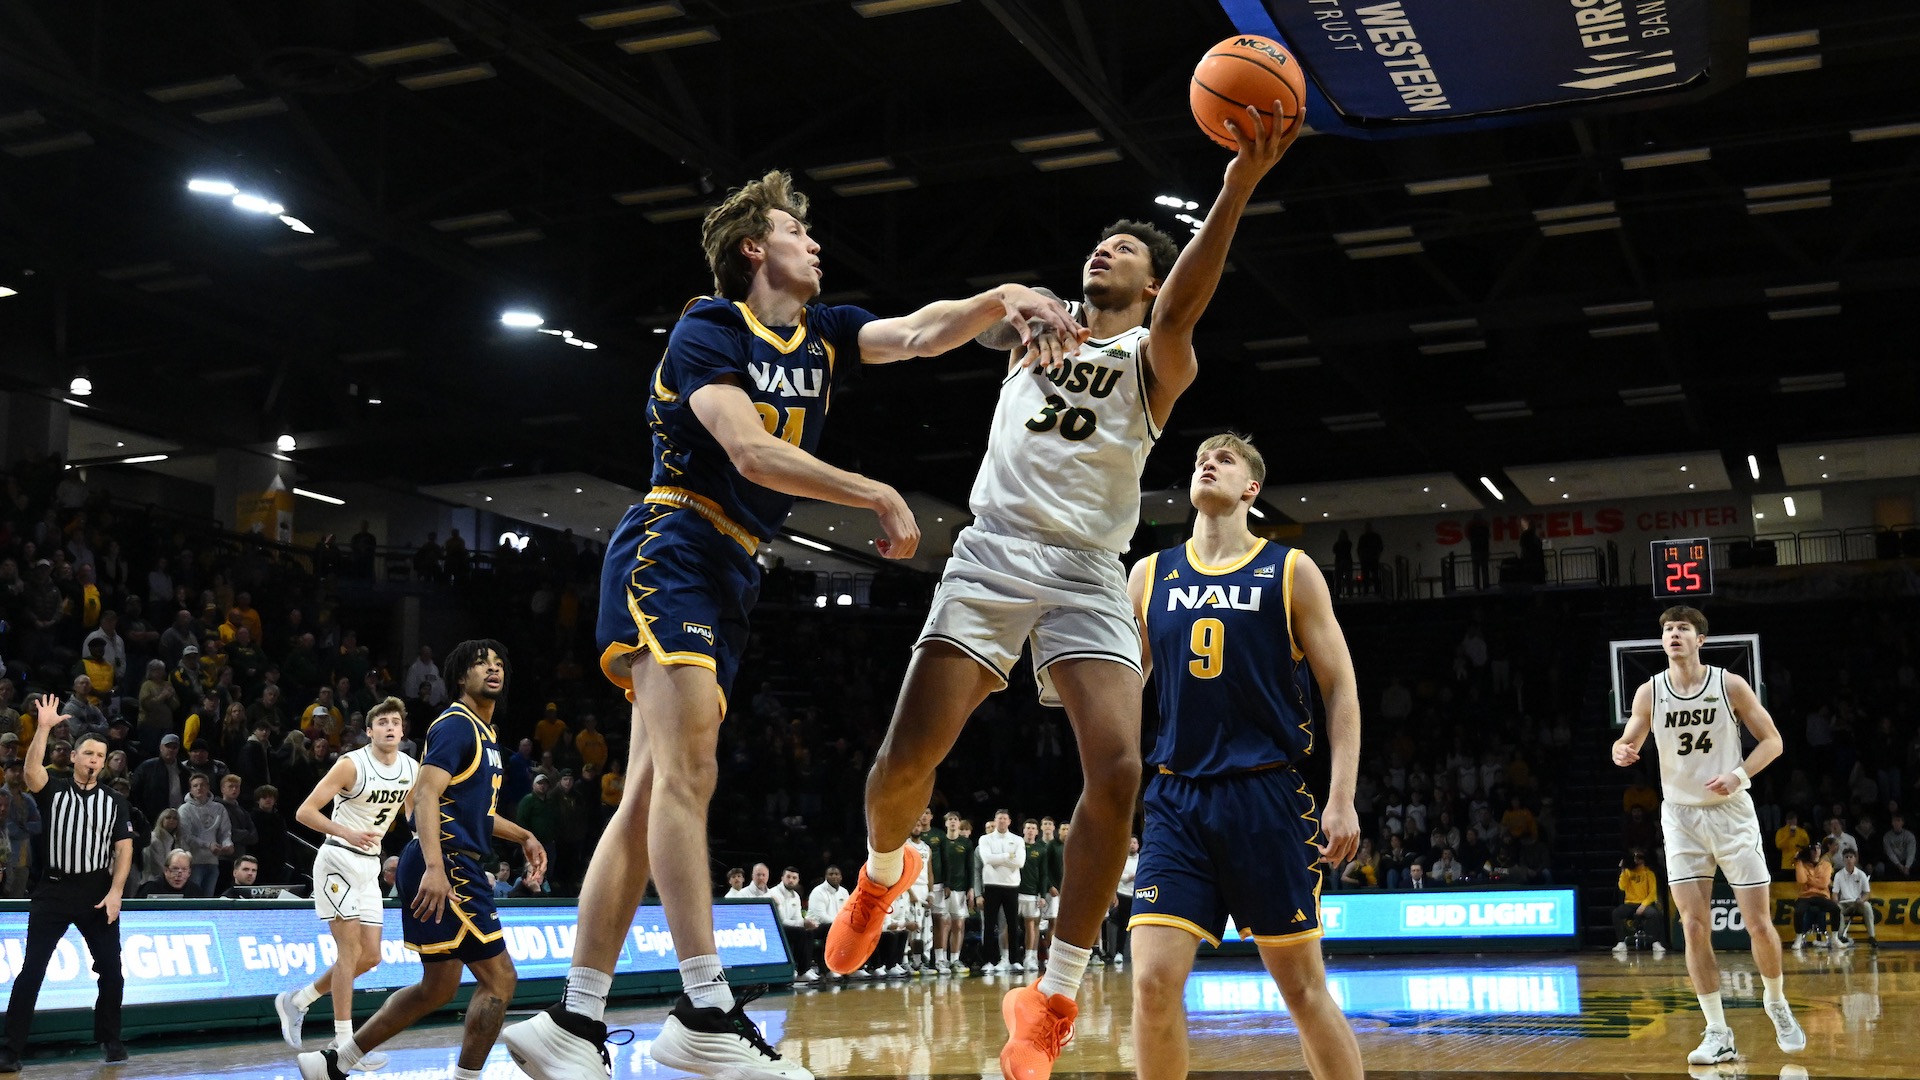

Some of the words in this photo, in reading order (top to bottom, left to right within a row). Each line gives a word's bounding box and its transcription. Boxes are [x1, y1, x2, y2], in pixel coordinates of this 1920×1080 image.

[1233, 38, 1287, 65] NCAA
[1355, 1, 1451, 112] WESTERN
[747, 361, 823, 397] NAU
[1033, 358, 1124, 398] DSU
[1025, 394, 1097, 441] 30
[1637, 506, 1738, 532] CENTER
[1690, 545, 1703, 560] 10
[1666, 561, 1701, 592] 25
[1167, 585, 1262, 611] NAU
[687, 625, 712, 639] NAU
[1189, 617, 1225, 679] 9
[1664, 708, 1717, 728] NDSU
[1677, 730, 1713, 756] 34
[366, 789, 409, 804] NDSU
[373, 808, 391, 826] 5
[1136, 890, 1155, 899] NAU
[1406, 904, 1466, 927] BUD
[1469, 902, 1554, 925] LIGHT
[1710, 906, 1746, 931] GO
[239, 935, 316, 977] Enjoy
[502, 926, 547, 961] UD
